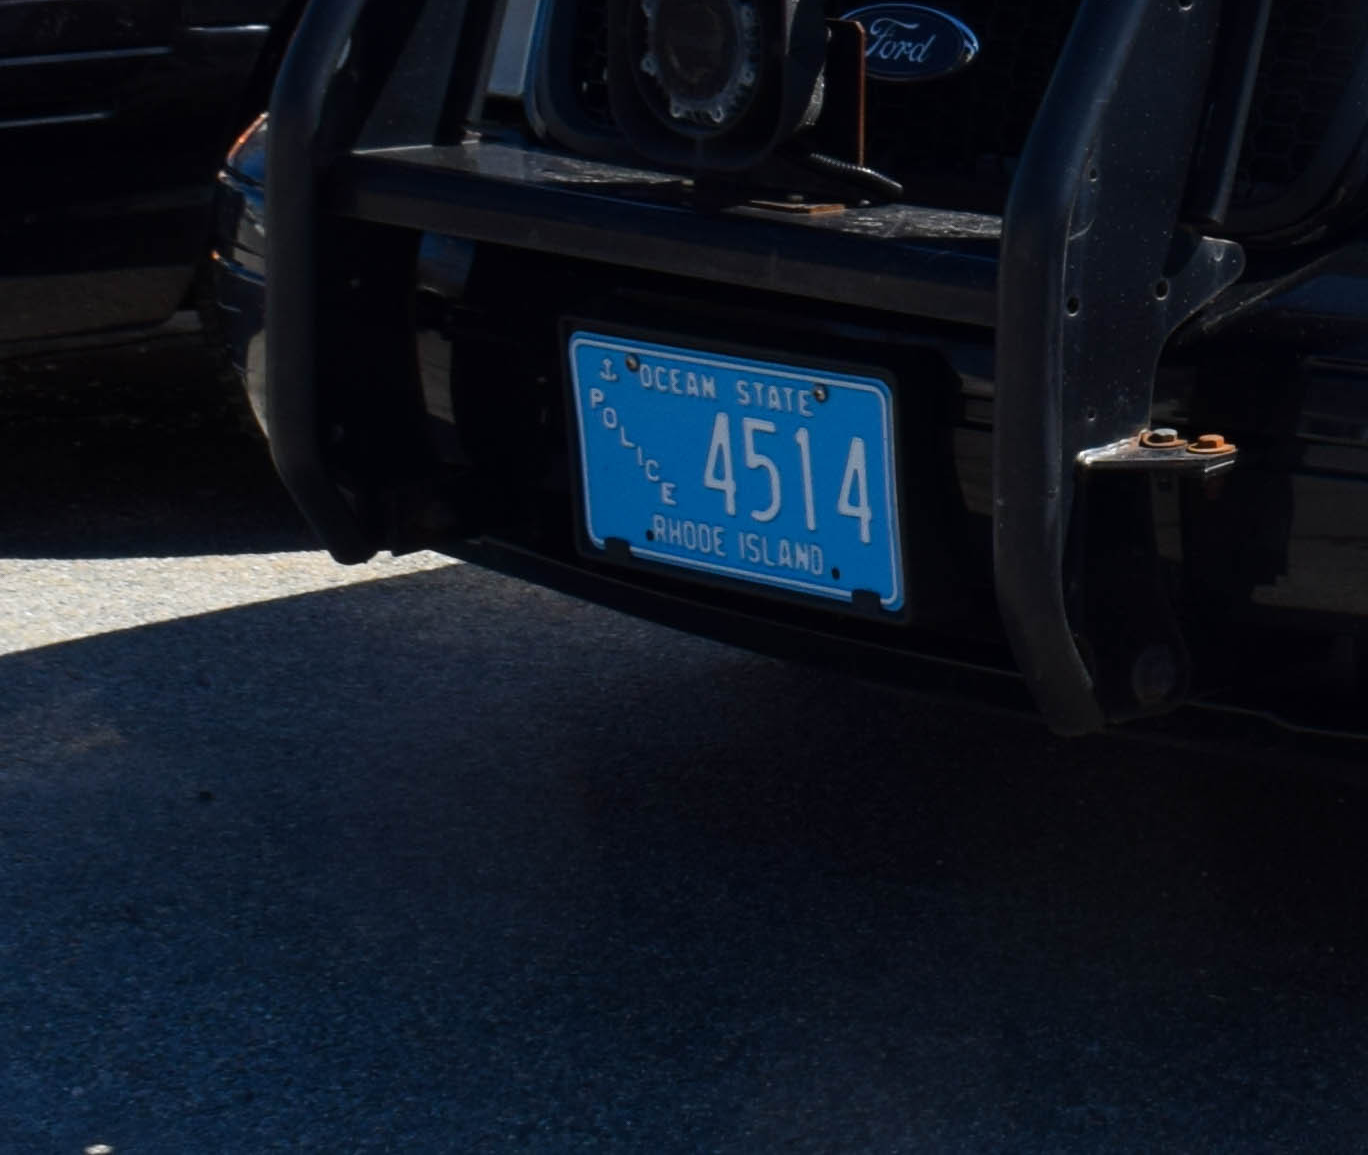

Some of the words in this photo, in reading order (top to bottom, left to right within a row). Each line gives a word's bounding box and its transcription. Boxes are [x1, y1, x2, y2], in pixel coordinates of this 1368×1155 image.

[865, 17, 937, 63] Ford
[638, 363, 717, 399] OCEAN
[736, 379, 815, 418] STATE
[589, 387, 677, 506] POLICE
[703, 411, 873, 544] 4514
[651, 513, 726, 557] RHODE
[738, 531, 824, 576] ISLAND
